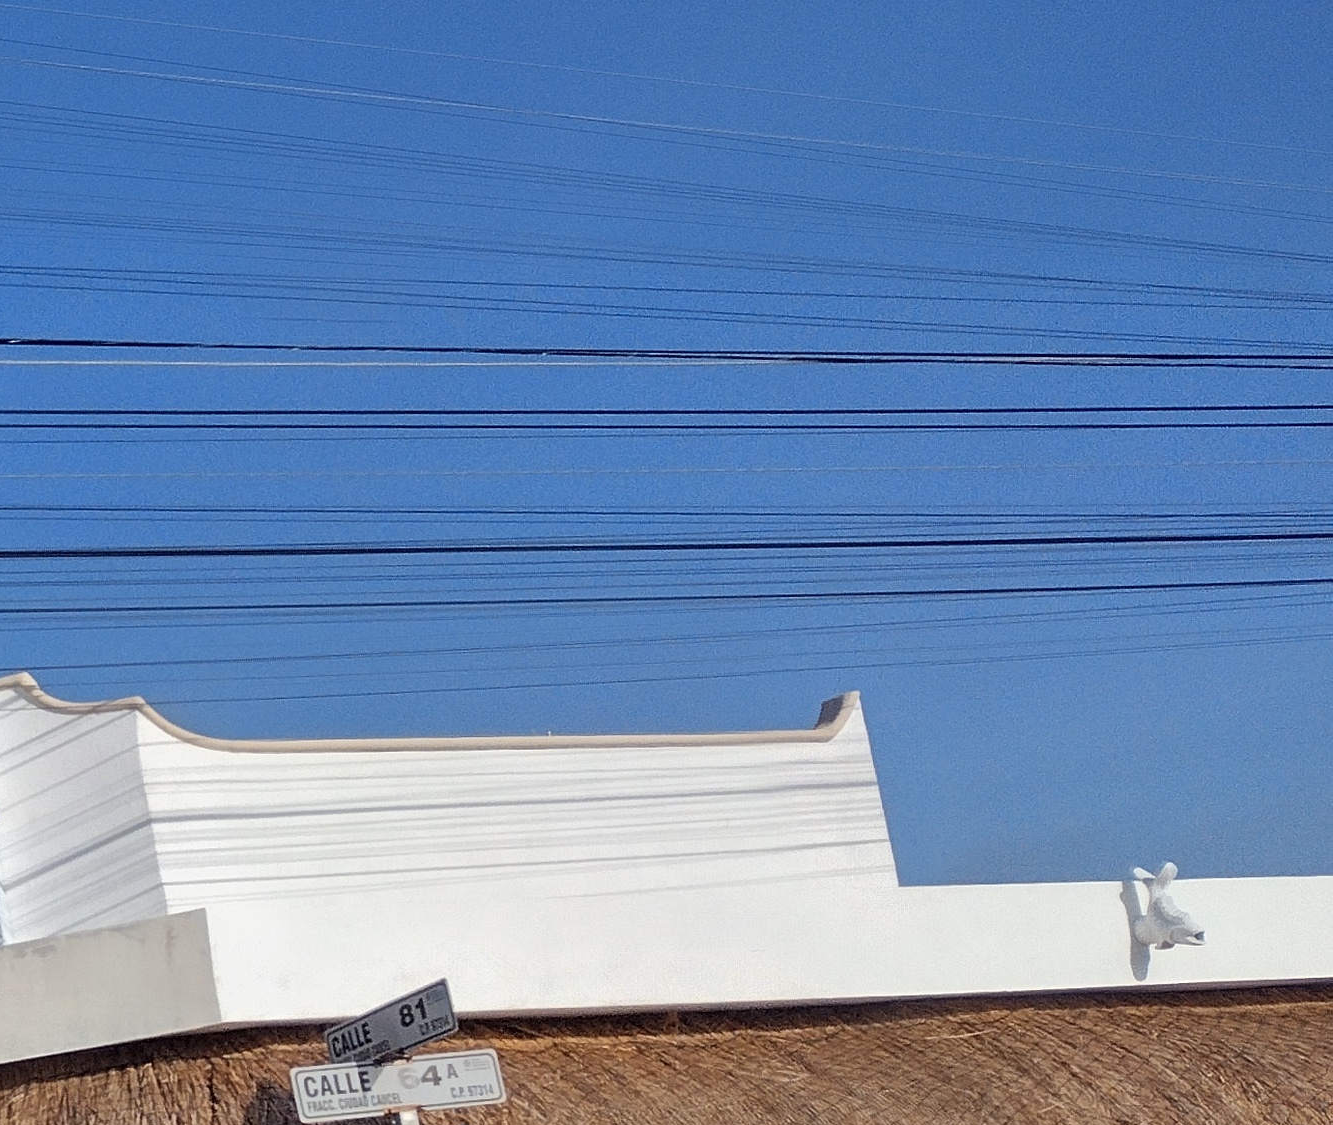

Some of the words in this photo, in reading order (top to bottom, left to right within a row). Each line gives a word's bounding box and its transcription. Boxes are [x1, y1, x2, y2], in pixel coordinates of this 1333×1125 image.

[331, 1021, 373, 1058] CALLE
[399, 997, 428, 1028] 81
[303, 1071, 372, 1098] CALLE
[397, 1065, 442, 1089] 64
[447, 1063, 459, 1079] A
